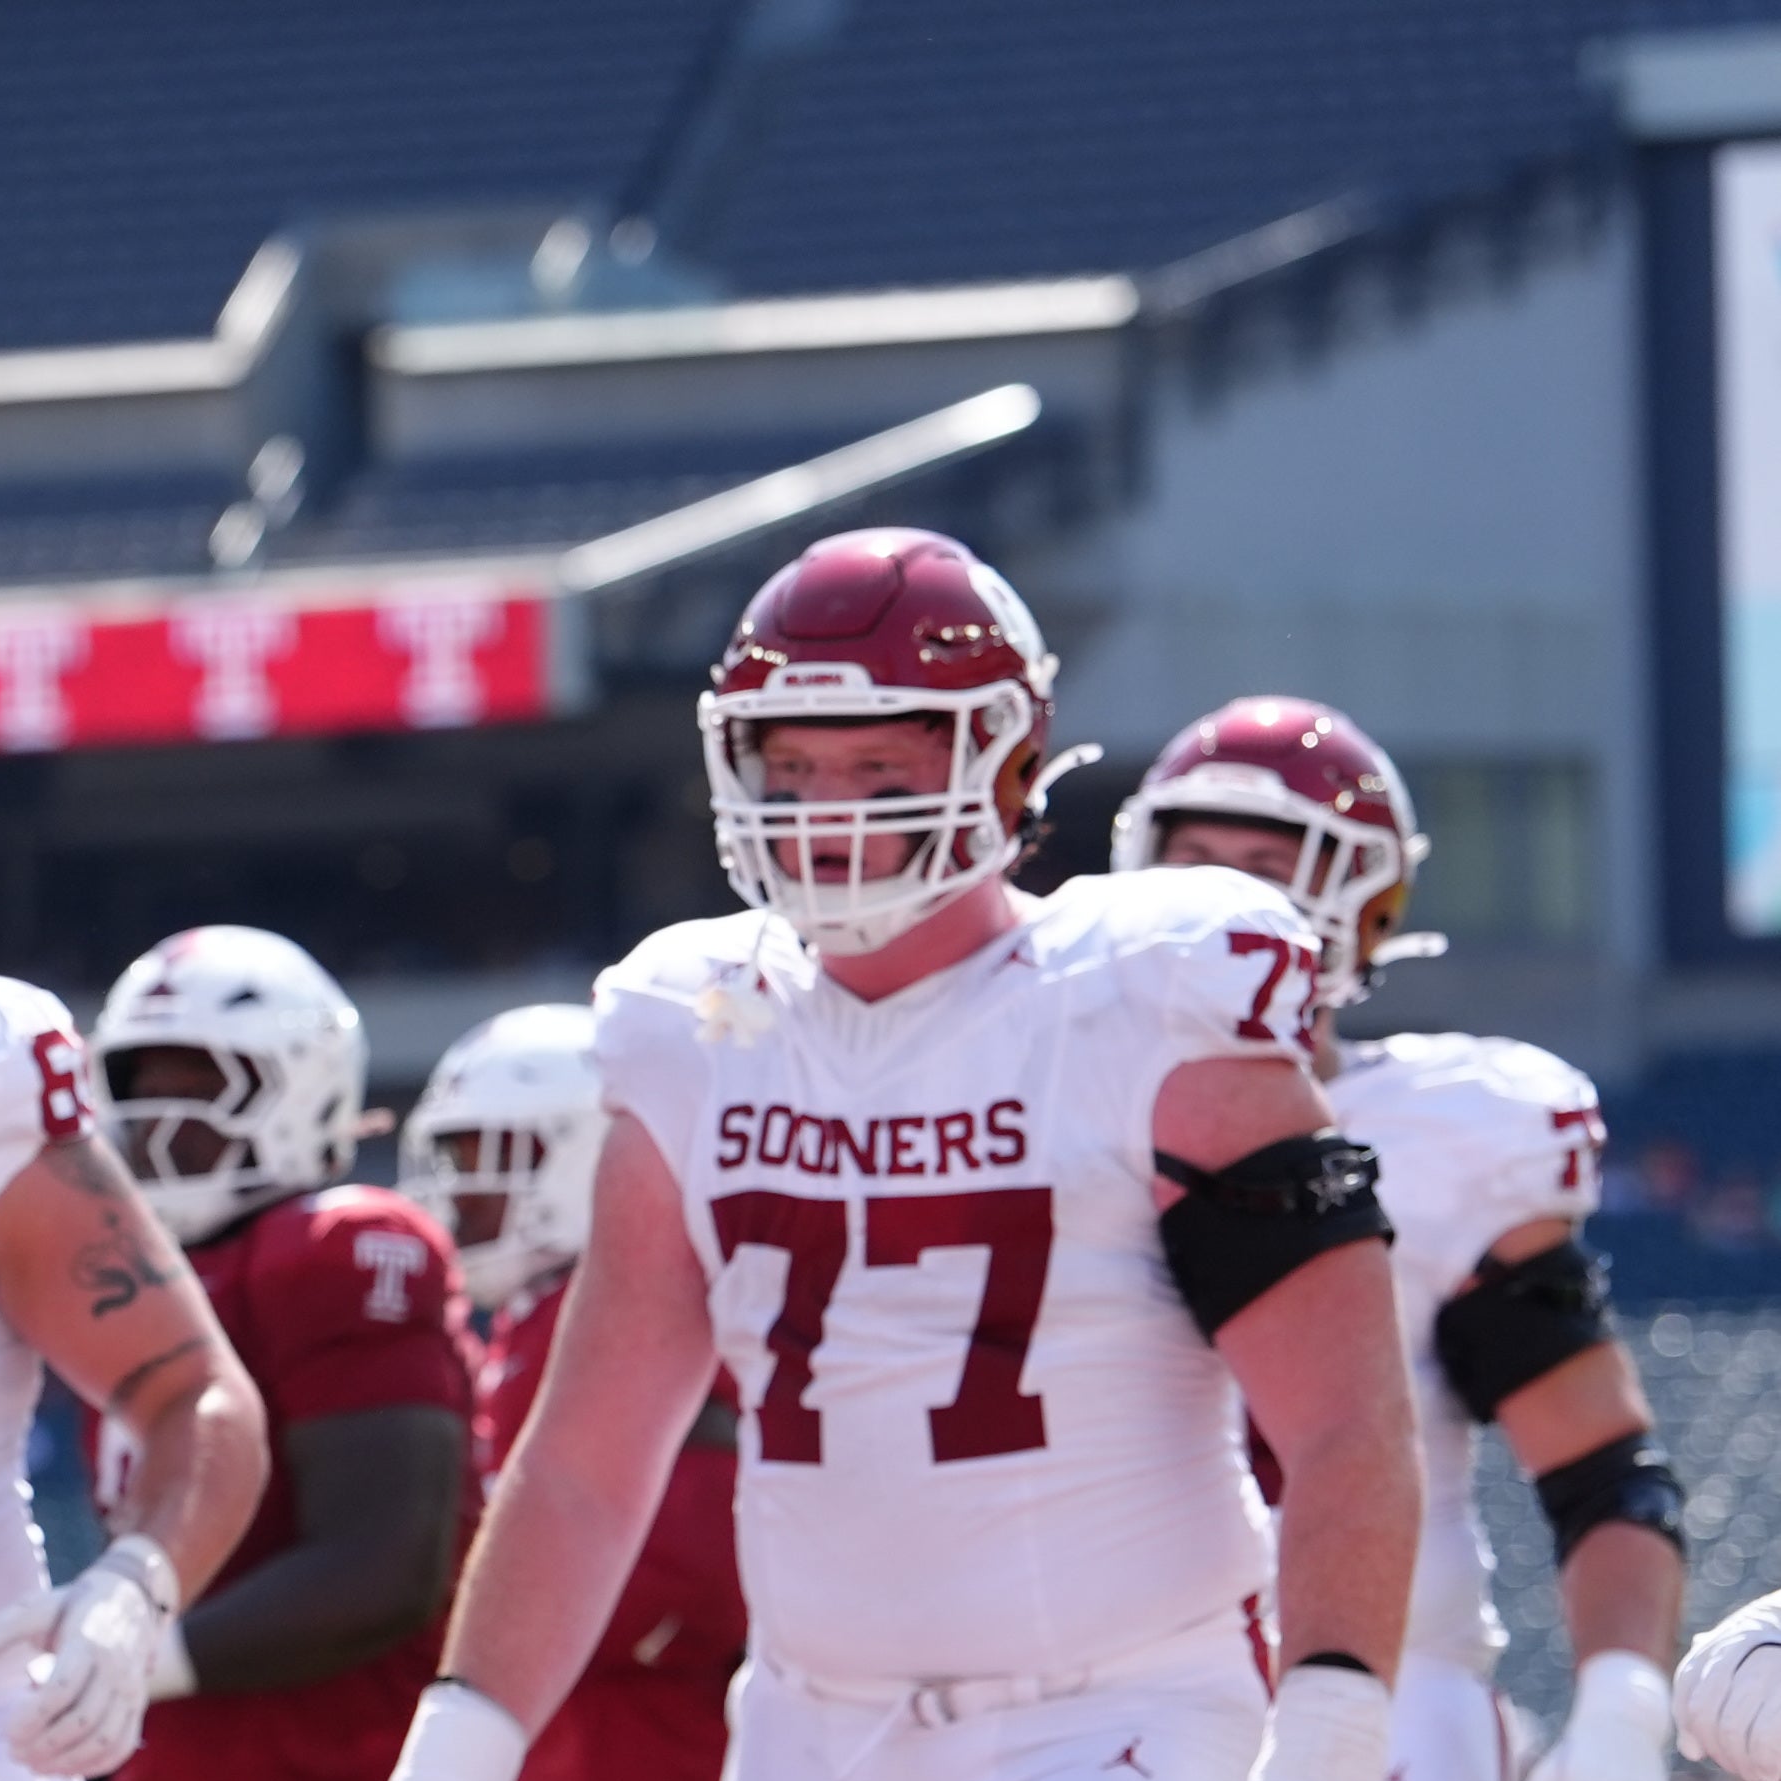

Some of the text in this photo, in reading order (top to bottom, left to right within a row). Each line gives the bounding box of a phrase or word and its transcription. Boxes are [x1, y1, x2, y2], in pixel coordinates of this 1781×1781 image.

[170, 596, 296, 741] T
[377, 584, 504, 729] T
[716, 1098, 1027, 1178] SOONERS
[352, 1229, 429, 1324] T
[710, 1187, 1054, 1465] 77
